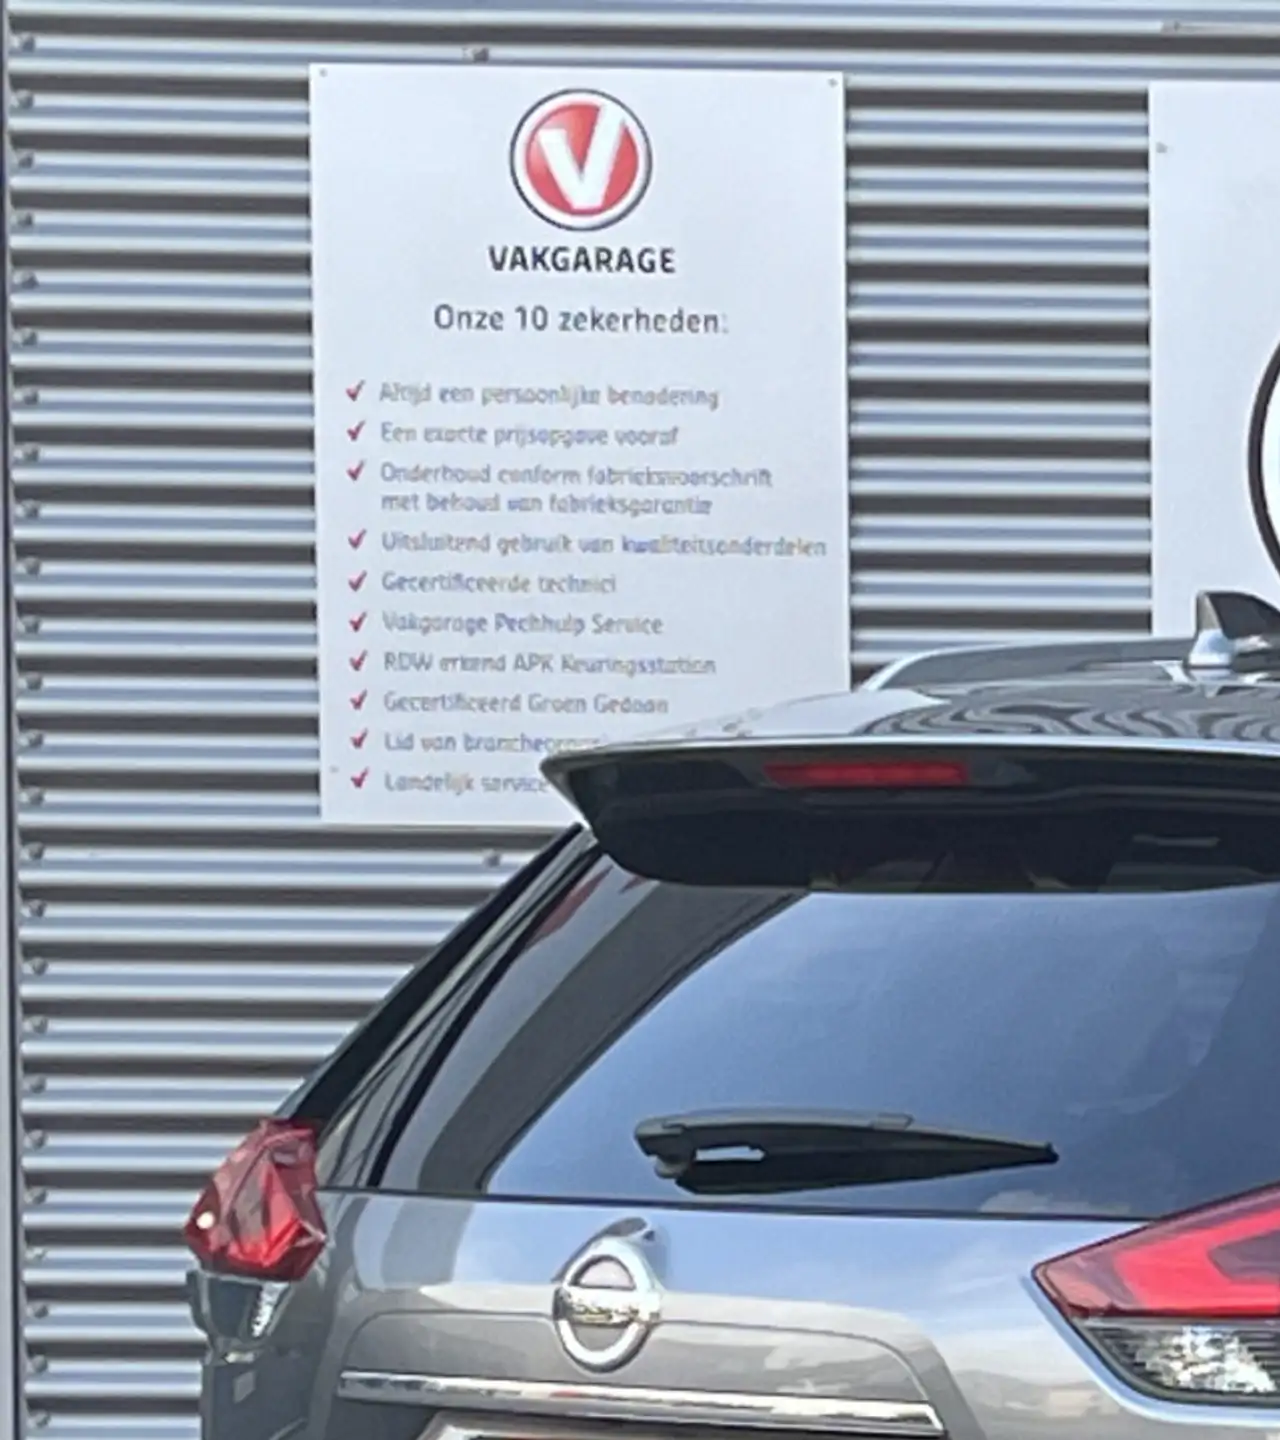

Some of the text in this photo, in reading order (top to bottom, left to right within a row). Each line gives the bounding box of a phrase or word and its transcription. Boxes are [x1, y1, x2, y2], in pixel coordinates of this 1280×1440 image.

[489, 246, 676, 273] VAKGARAGE
[433, 304, 730, 335] Onze 10 zekerheden:
[380, 382, 431, 407] Altijd
[439, 386, 474, 403] een
[607, 386, 719, 411] benadering
[381, 422, 417, 442] Een
[423, 426, 487, 443] exacte
[614, 426, 679, 446] vooraf
[380, 462, 491, 483] Onderhoud
[498, 464, 581, 484] conform
[381, 493, 419, 511] met
[426, 493, 500, 512] behoud
[507, 497, 542, 511] van
[381, 532, 491, 552] Uitsluitend
[497, 535, 572, 557] gebruik
[578, 538, 613, 553] van
[381, 571, 617, 593] Gecertificeerde technici
[381, 611, 664, 637] Vakgarage Pechhulp Service
[383, 652, 717, 678] RDW erkend APK Keuringsstation
[384, 691, 669, 714] Gecertificeerd Groen Gedaan
[384, 732, 414, 752] Lid
[421, 736, 456, 751] van
[384, 772, 473, 796] Landelijk
